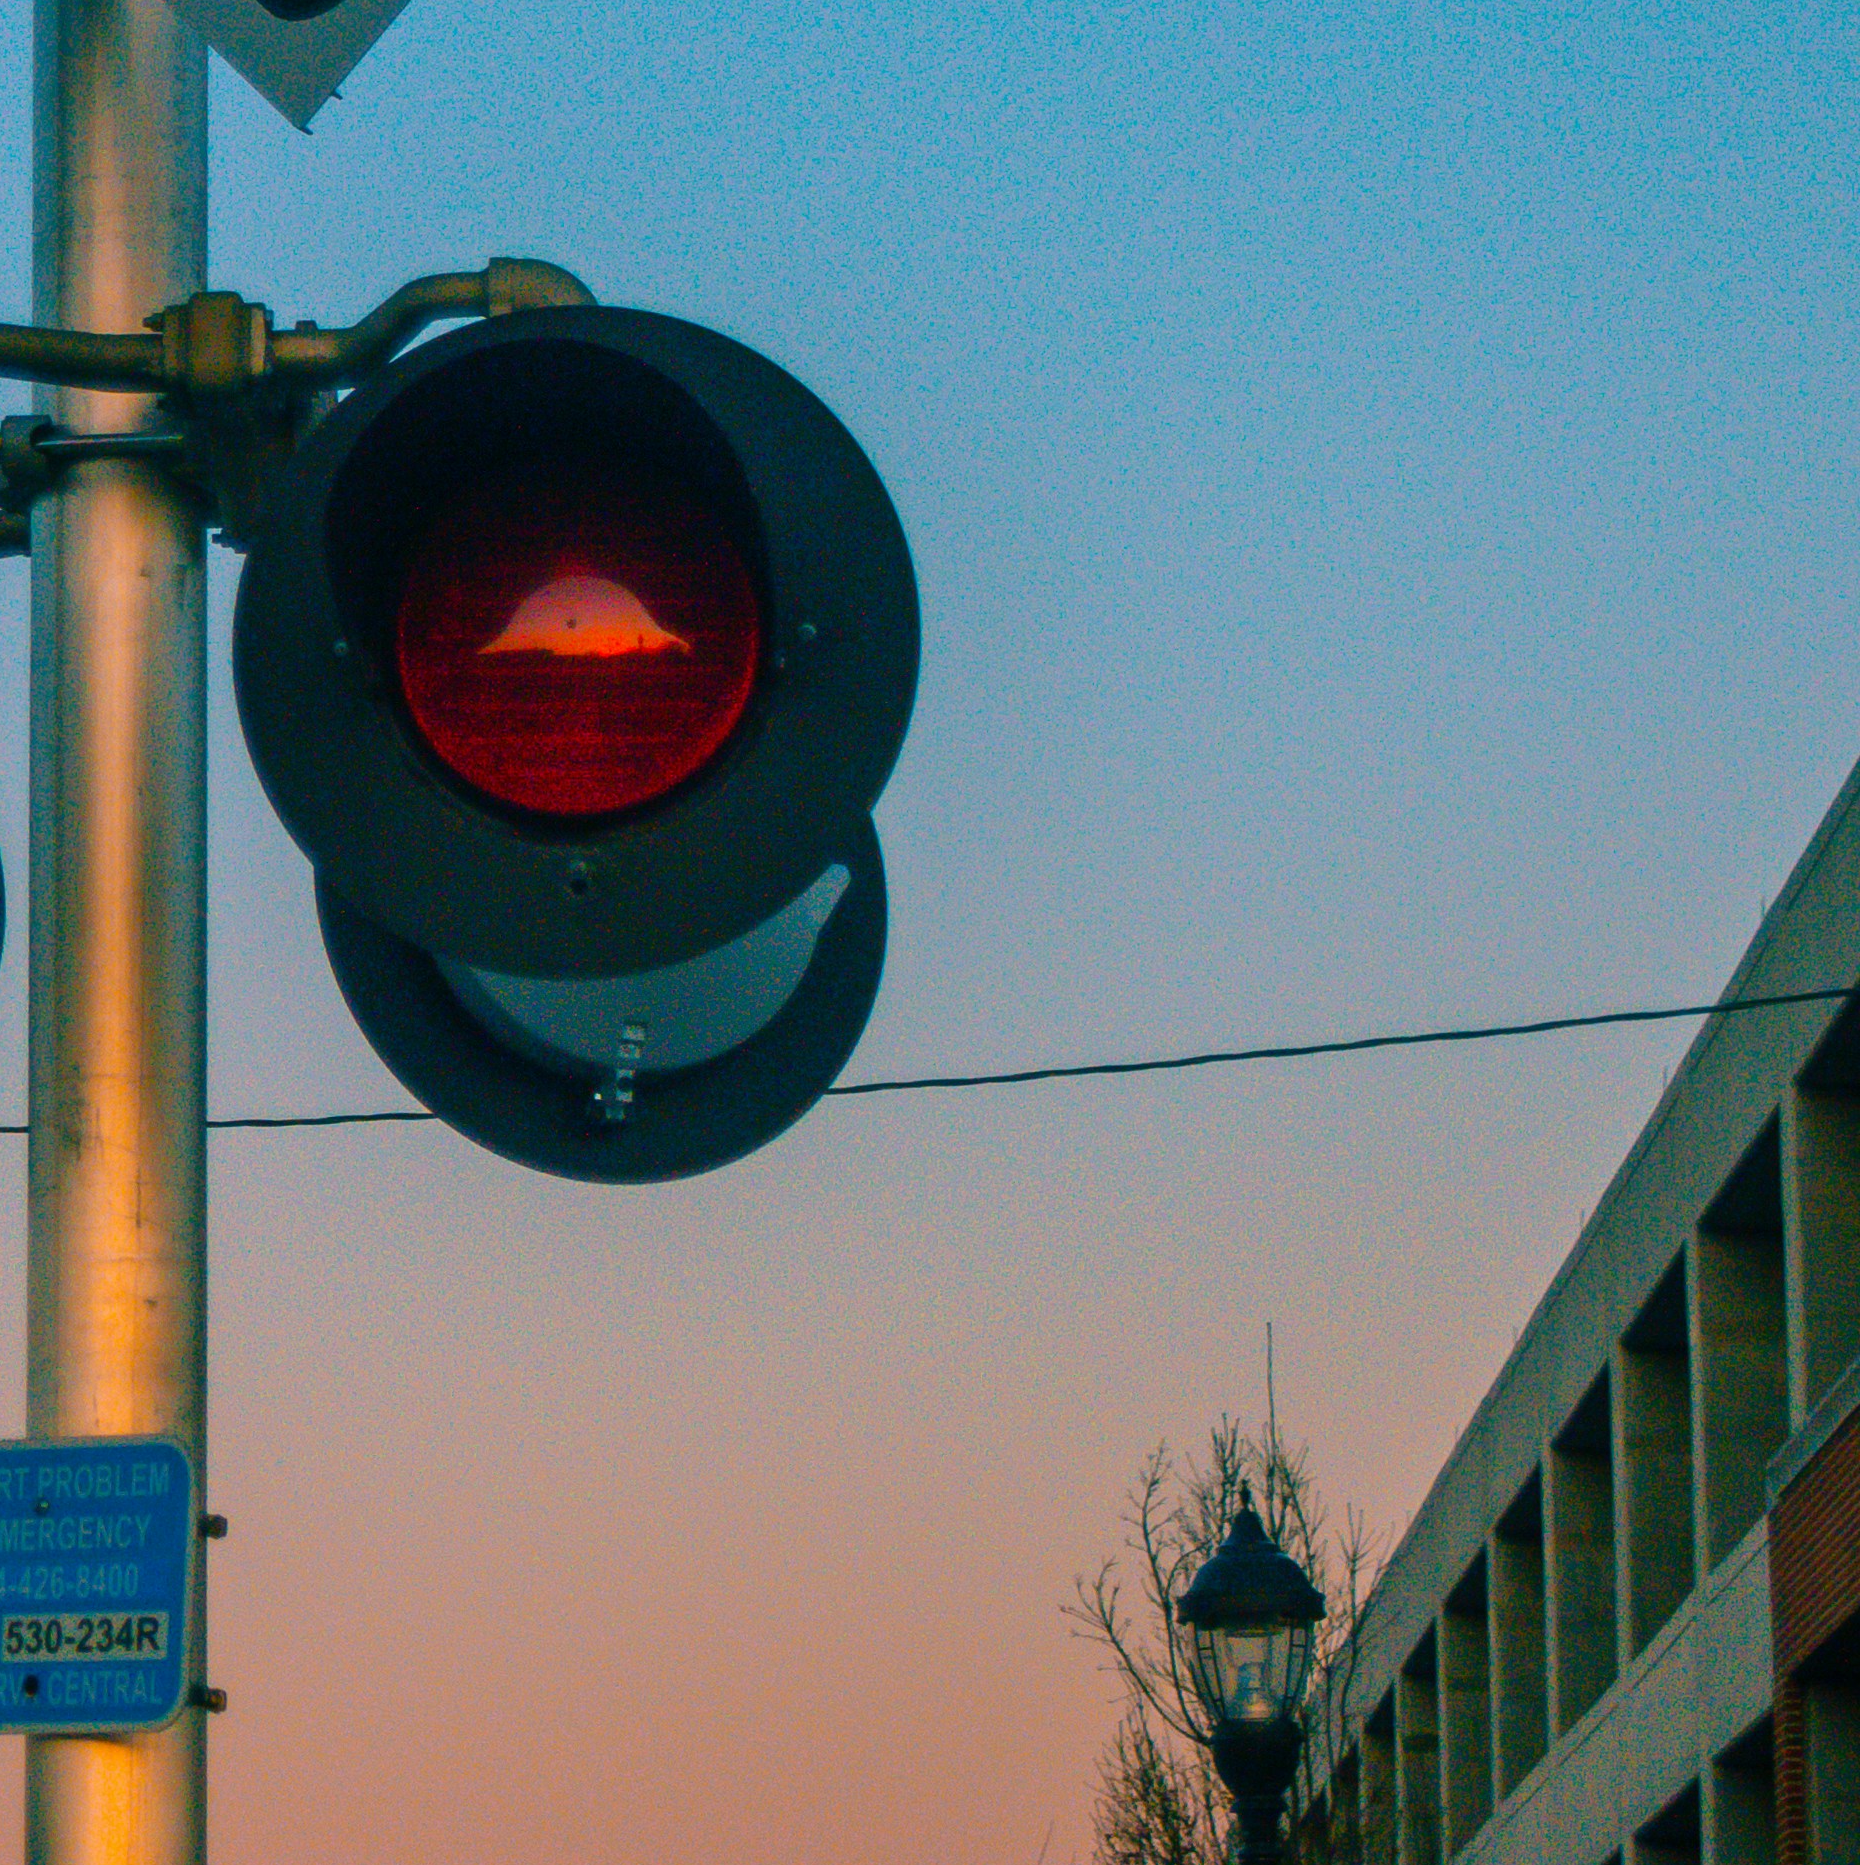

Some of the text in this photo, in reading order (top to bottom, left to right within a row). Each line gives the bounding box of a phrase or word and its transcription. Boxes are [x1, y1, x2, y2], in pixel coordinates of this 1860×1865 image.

[38, 1463, 169, 1497] PROBLEM
[6, 1617, 160, 1655] 530-234R
[46, 1669, 162, 1706] CENTRAL
